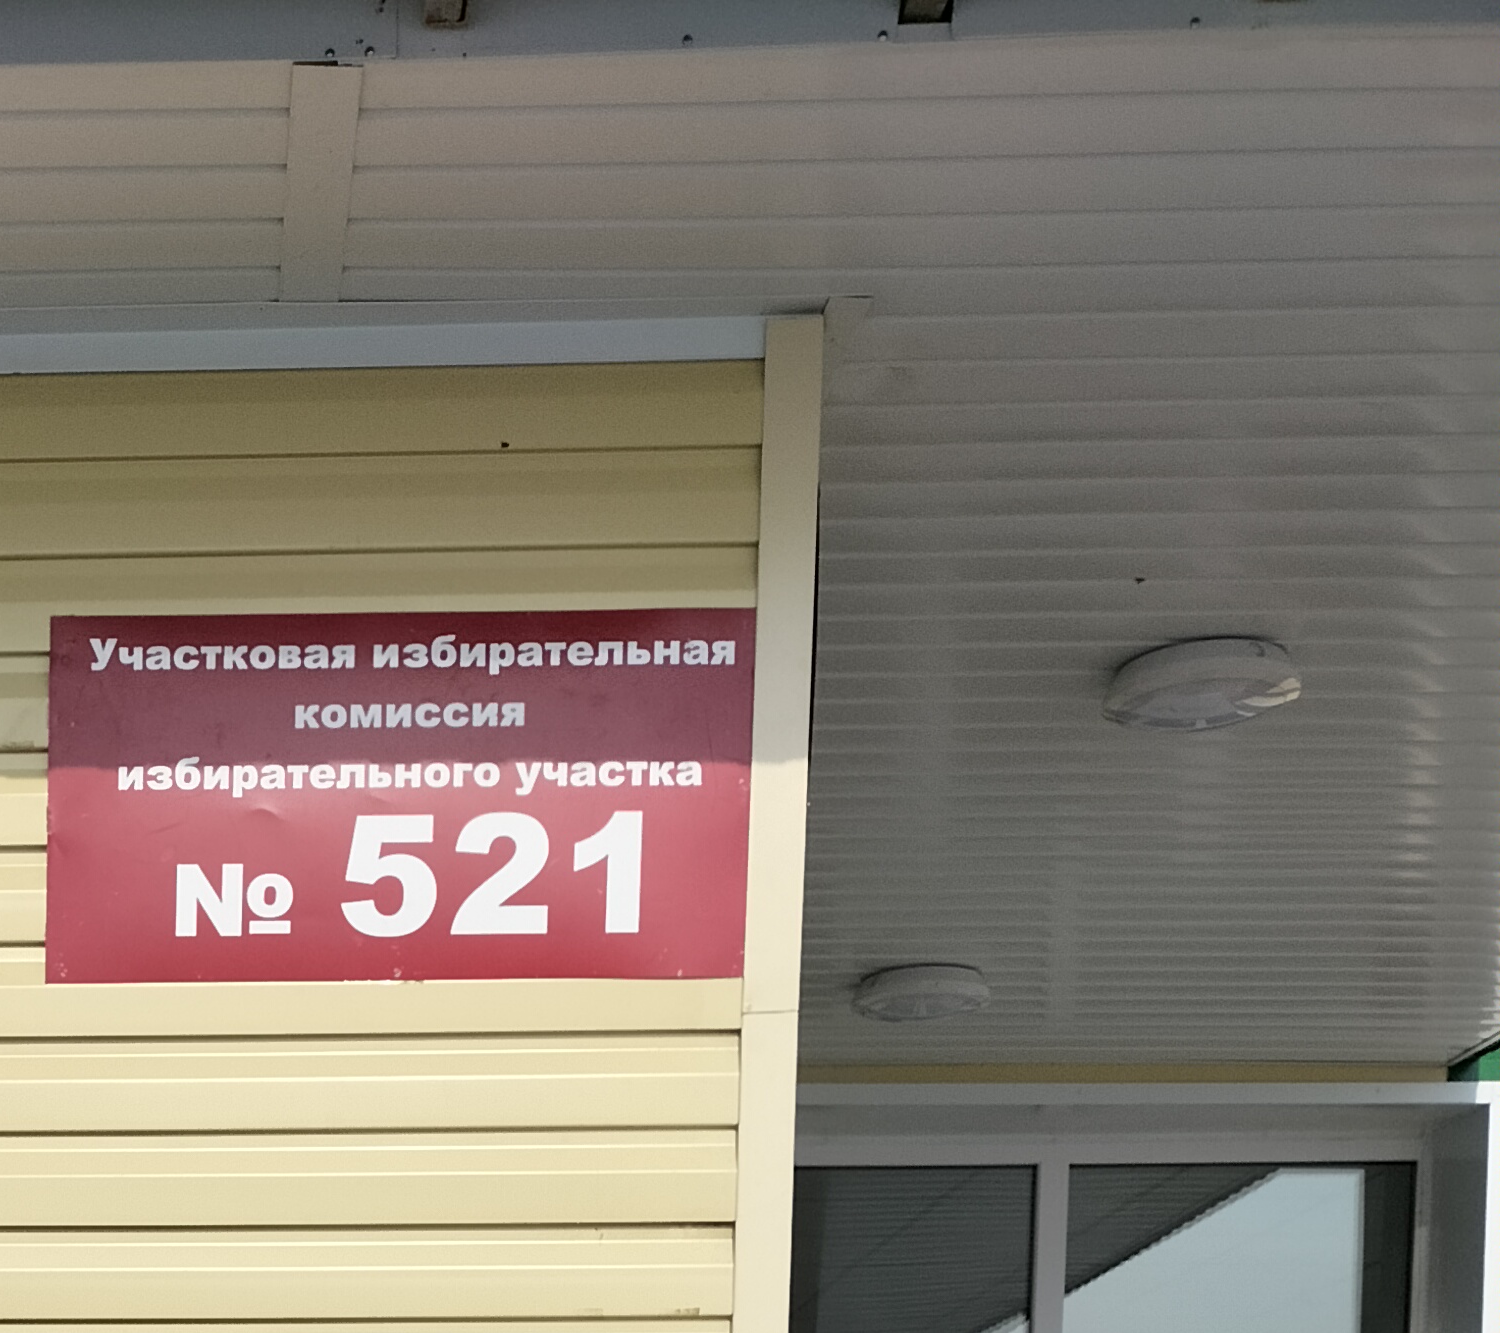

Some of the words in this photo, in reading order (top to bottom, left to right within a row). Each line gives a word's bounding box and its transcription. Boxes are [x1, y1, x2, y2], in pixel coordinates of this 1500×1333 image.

[89, 637, 356, 672] Участковая
[372, 634, 736, 675] избирательная
[294, 702, 525, 729] комиссия
[117, 756, 501, 798] избирательного
[514, 760, 703, 797] участка
[175, 863, 294, 937] №
[340, 810, 644, 938] 521
